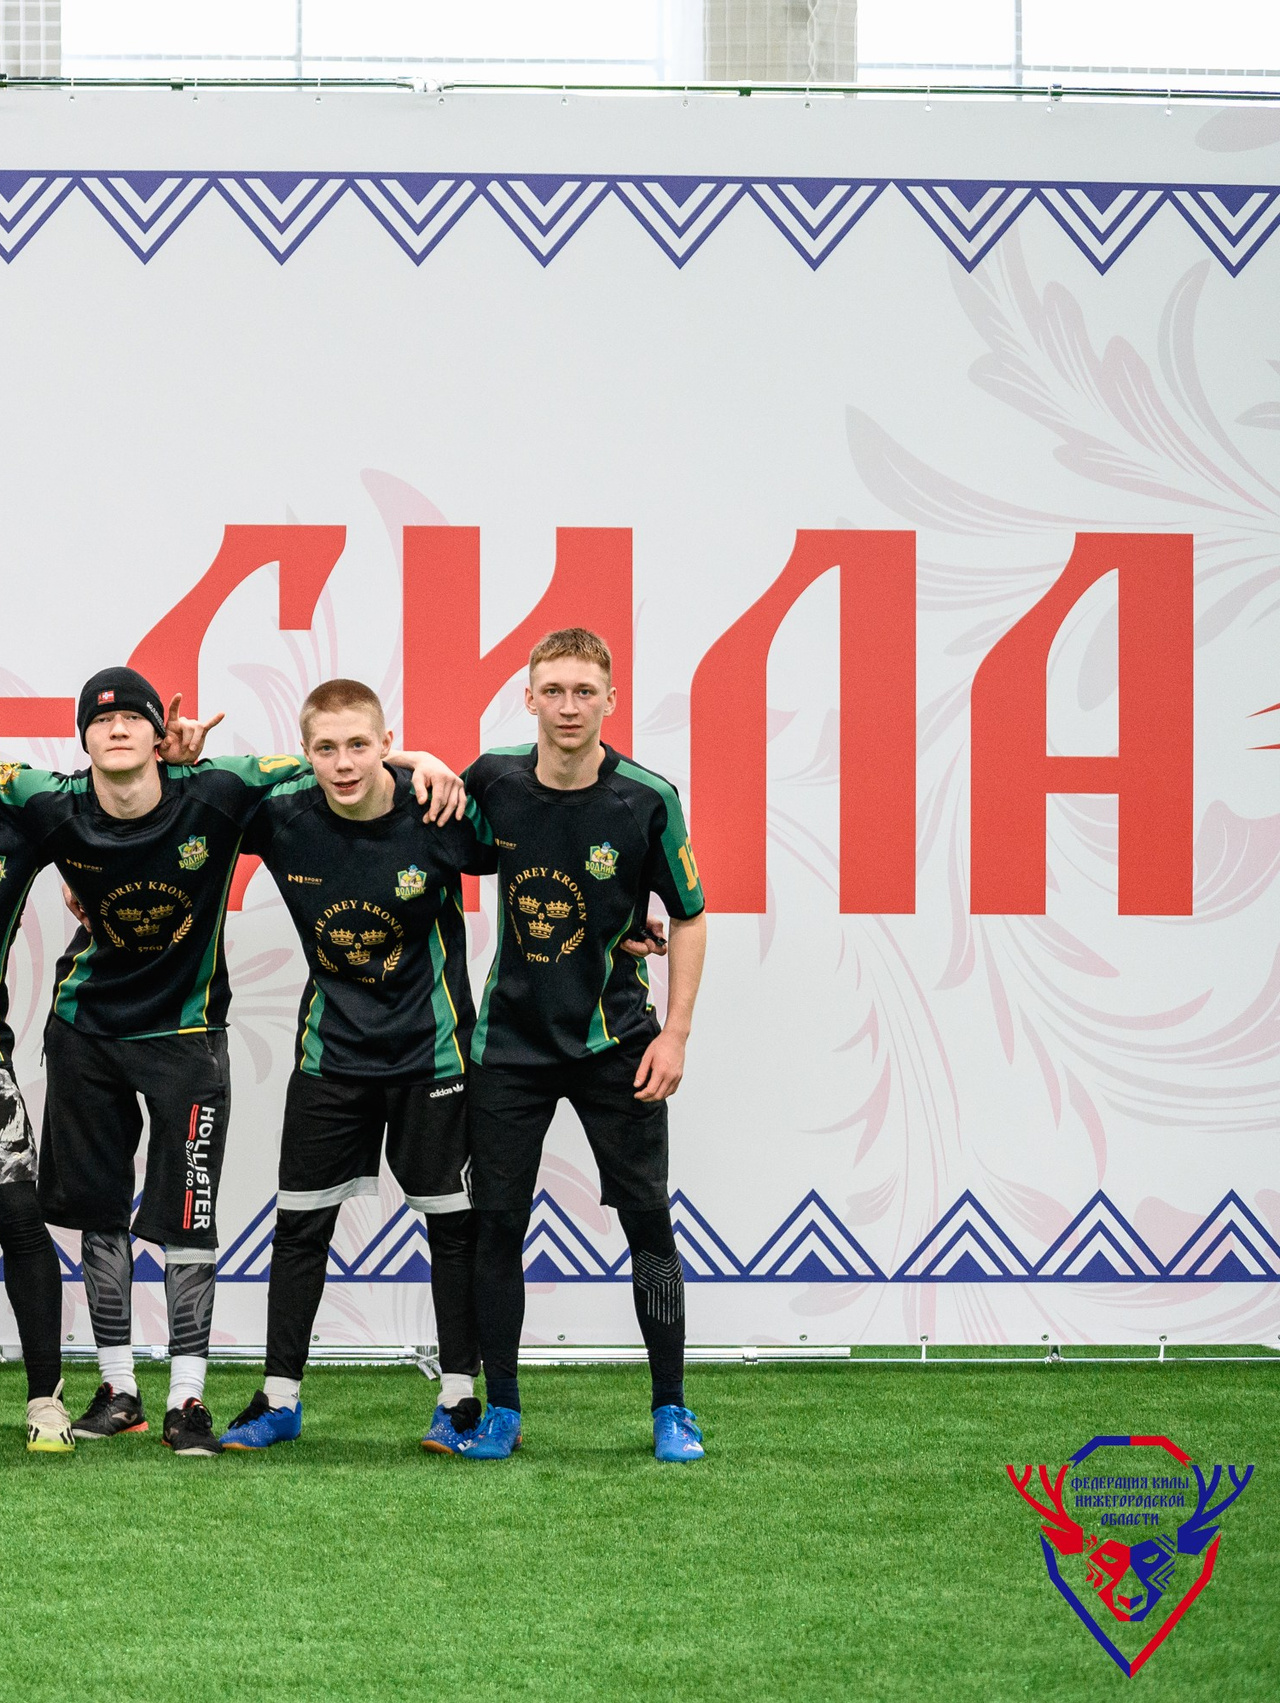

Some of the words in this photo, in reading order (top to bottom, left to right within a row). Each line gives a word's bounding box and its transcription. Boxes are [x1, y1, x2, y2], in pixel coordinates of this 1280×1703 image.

[177, 848, 209, 869] ВОДНИК
[584, 860, 617, 875] ВОДНИК
[99, 898, 111, 916] DIE
[107, 881, 143, 901] DREY
[148, 880, 193, 909] KRONEN
[394, 886, 426, 897] ВОДНИК
[515, 867, 549, 884] DREY
[551, 869, 587, 922] KRONEN
[323, 899, 358, 919] DREY
[361, 902, 404, 938] KRONEN
[525, 952, 550, 963] 5760
[429, 1088, 454, 1099] adidas
[185, 1139, 195, 1169] Surf
[191, 1106, 216, 1230] HOLLISTER
